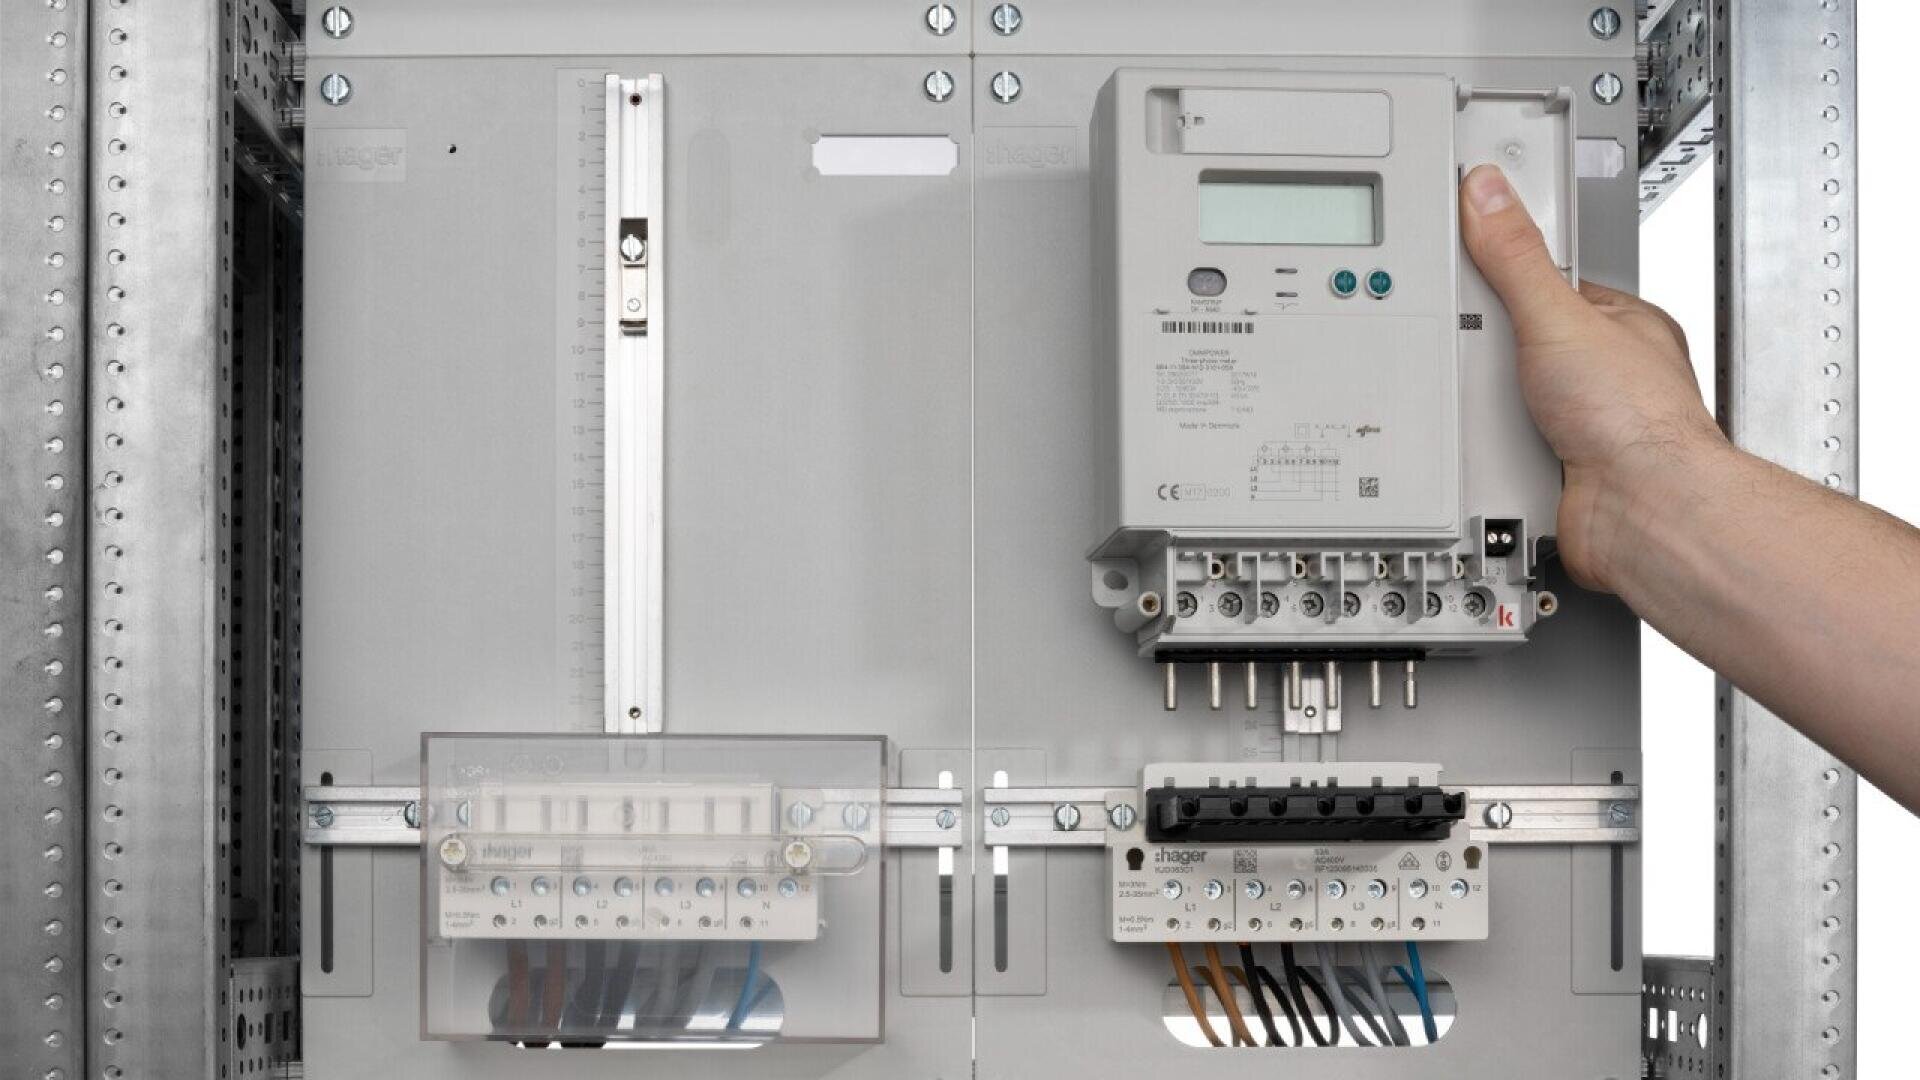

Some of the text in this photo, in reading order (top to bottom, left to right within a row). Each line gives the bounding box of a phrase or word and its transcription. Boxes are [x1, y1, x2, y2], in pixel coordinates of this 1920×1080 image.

[762, 901, 770, 910] N
[1184, 902, 1443, 912] L1 L2 L3 N
